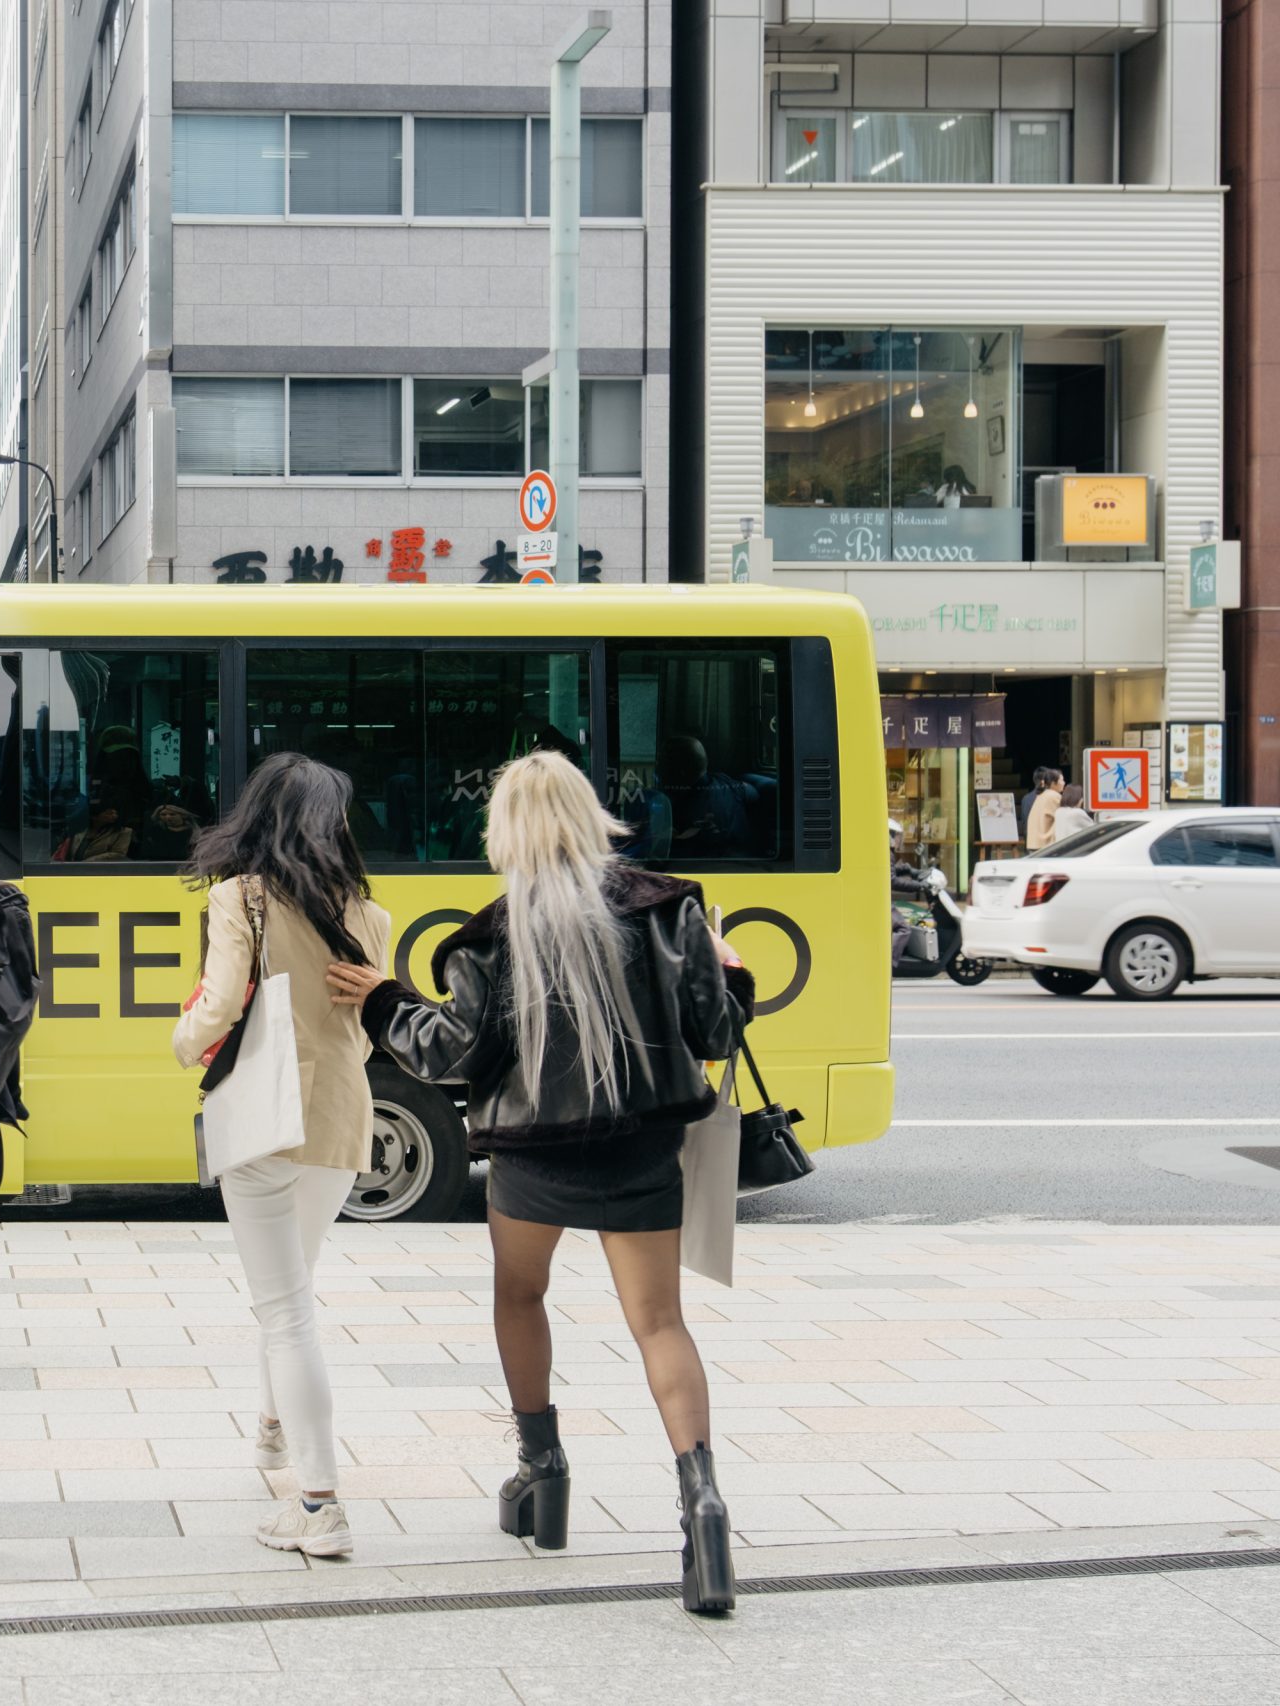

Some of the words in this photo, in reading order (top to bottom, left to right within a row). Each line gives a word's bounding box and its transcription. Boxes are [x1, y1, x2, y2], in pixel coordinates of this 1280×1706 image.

[830, 512, 885, 525] 京橋千疋屋
[930, 603, 999, 633] 千疋屋
[882, 716, 962, 735] 千疋屋
